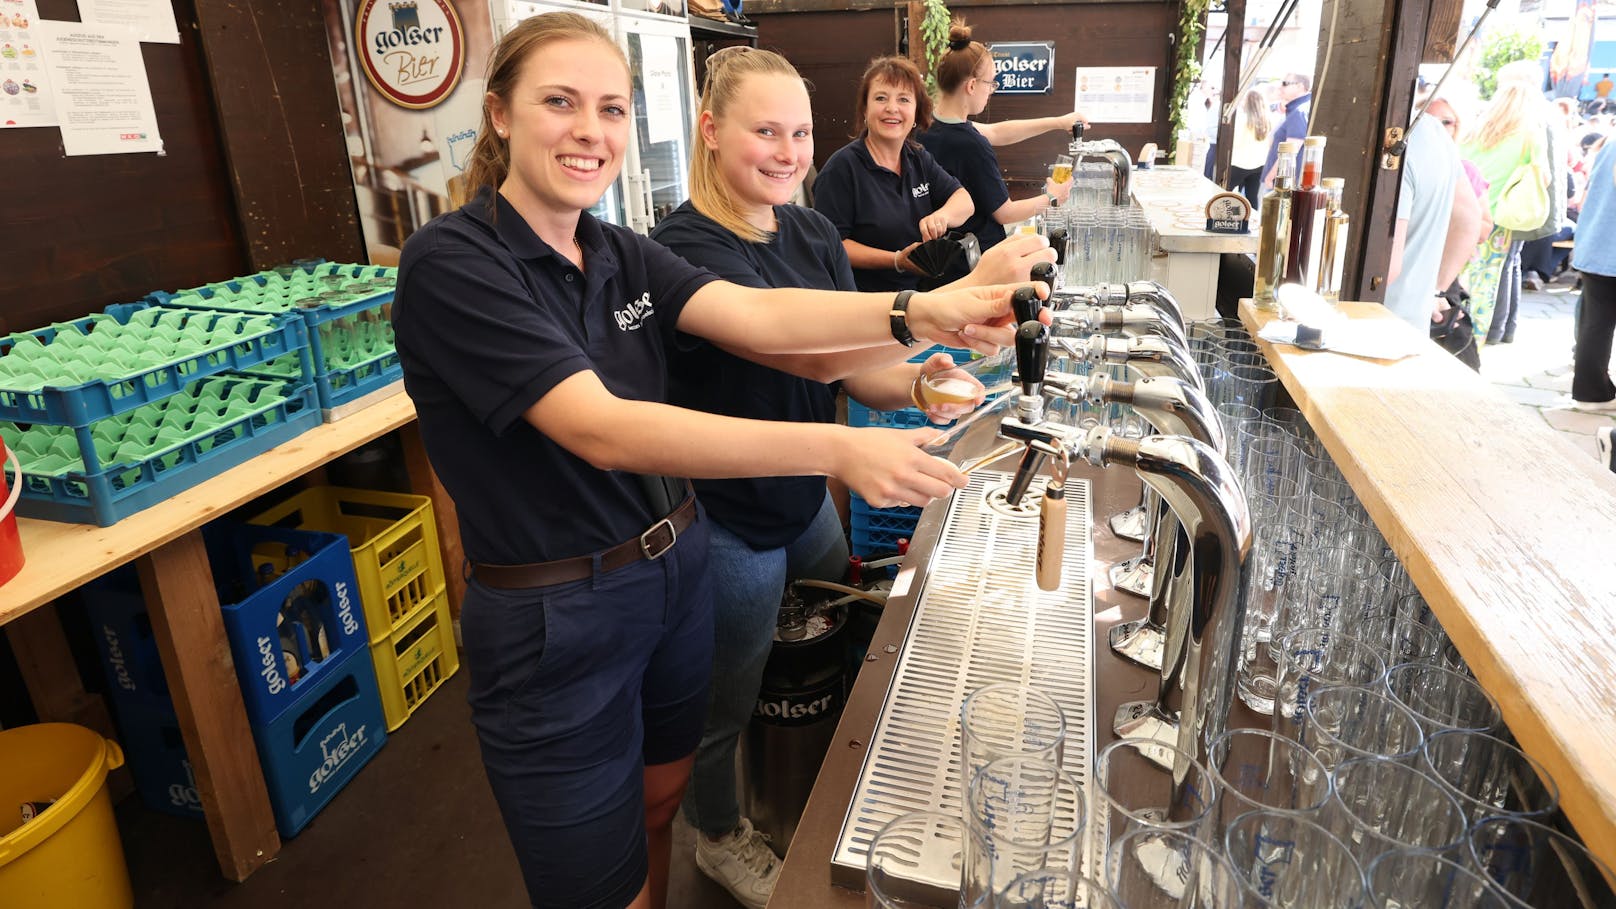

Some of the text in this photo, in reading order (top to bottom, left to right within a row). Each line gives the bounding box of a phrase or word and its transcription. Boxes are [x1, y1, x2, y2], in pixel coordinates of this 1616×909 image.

[375, 24, 443, 54] golser
[384, 50, 440, 85] Bier
[993, 56, 1048, 76] golser
[1002, 73, 1035, 90] Bier
[1214, 220, 1240, 230] golser
[335, 582, 359, 635] golser
[257, 636, 286, 695] golser
[309, 725, 367, 794] golser
